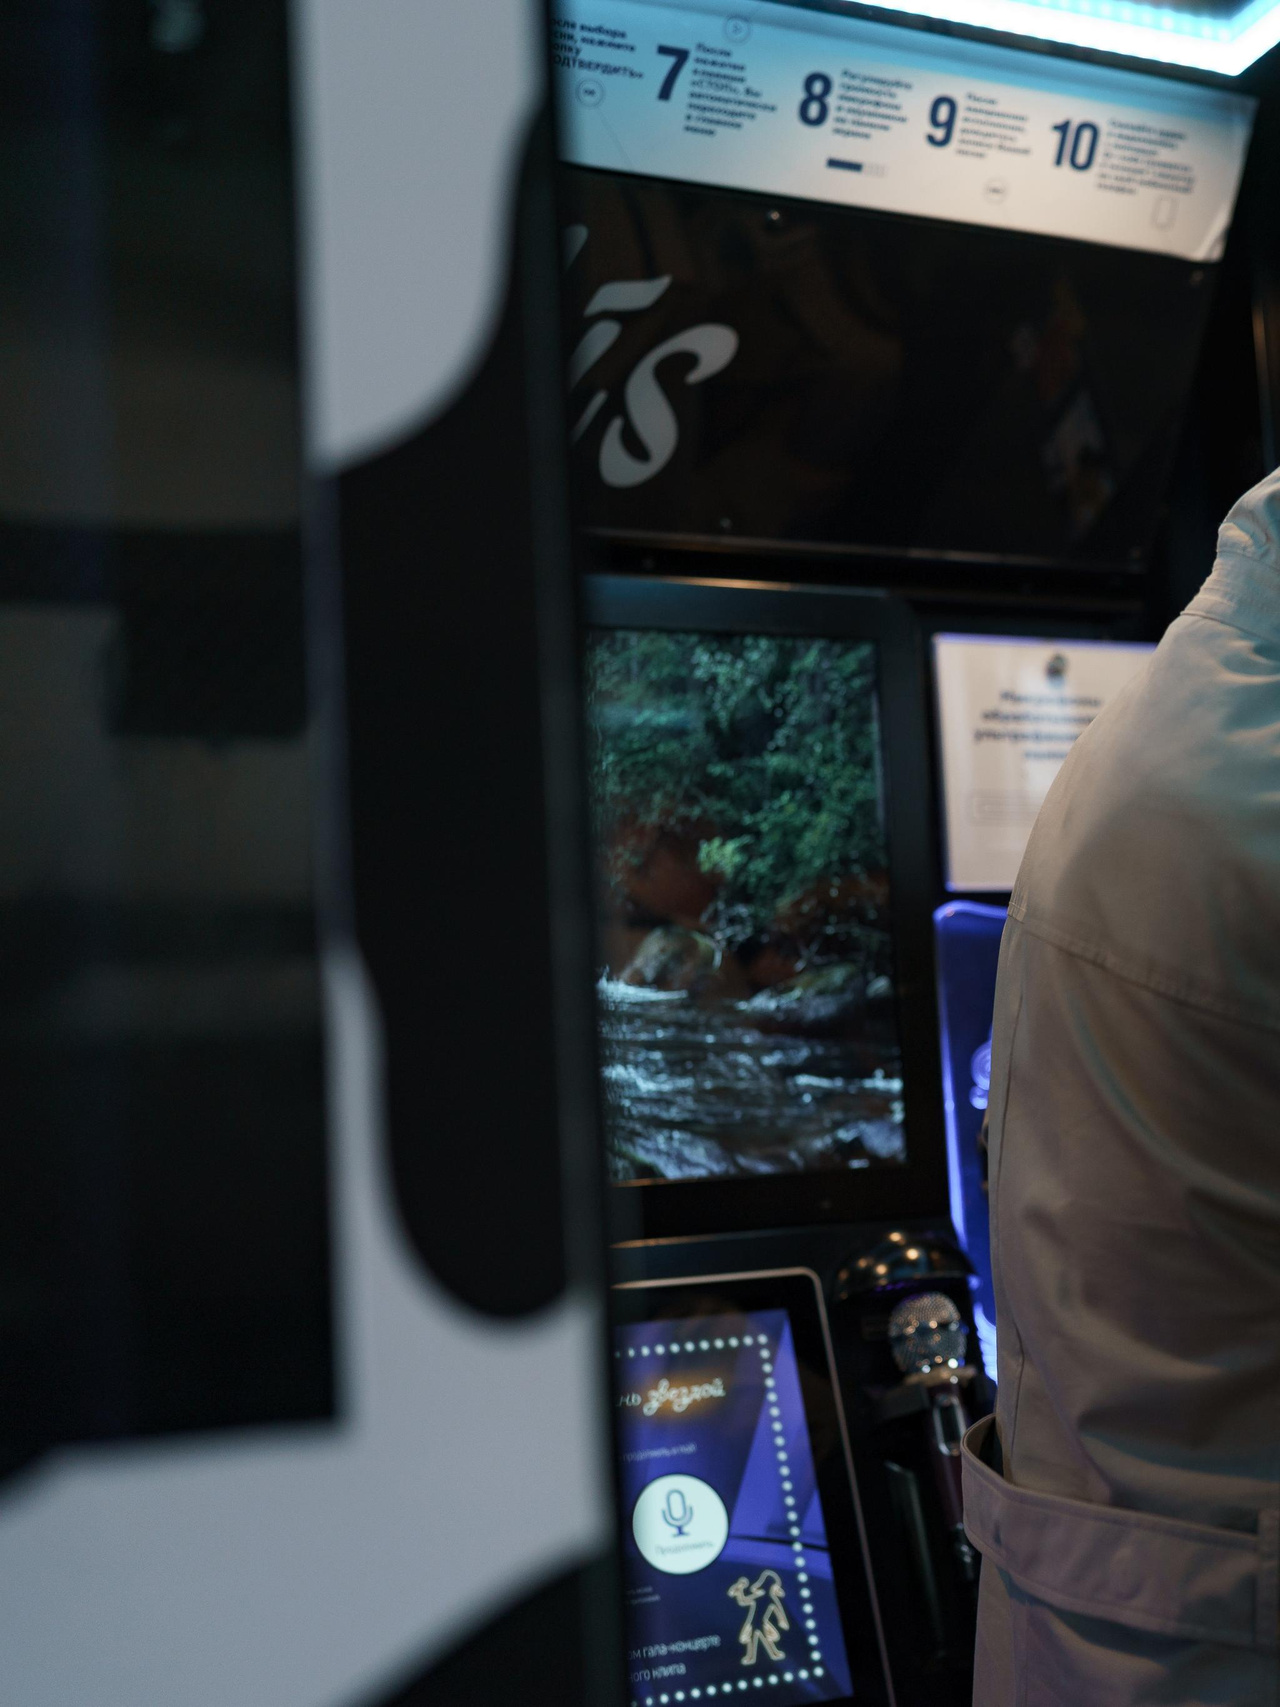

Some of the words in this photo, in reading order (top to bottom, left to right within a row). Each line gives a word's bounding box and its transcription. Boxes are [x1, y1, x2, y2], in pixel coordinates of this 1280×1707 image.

[657, 44, 690, 101] 7
[798, 72, 833, 127] 8
[926, 95, 957, 148] 9
[1051, 118, 1099, 171] 10
